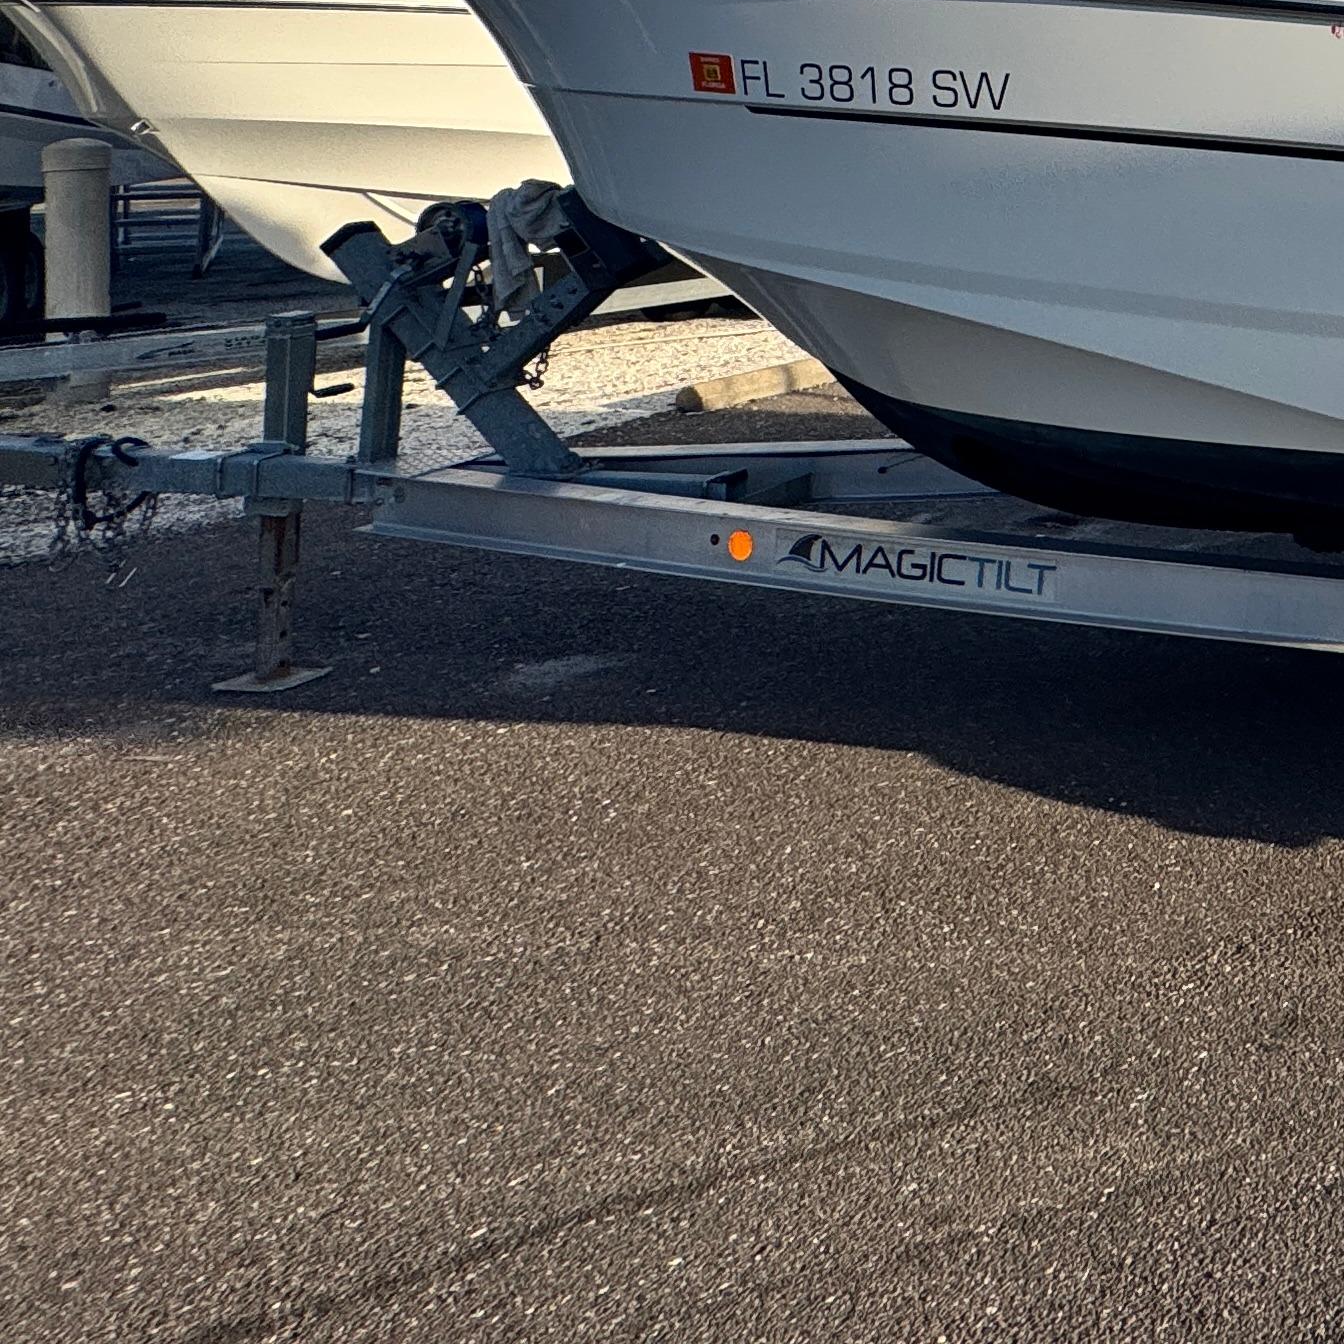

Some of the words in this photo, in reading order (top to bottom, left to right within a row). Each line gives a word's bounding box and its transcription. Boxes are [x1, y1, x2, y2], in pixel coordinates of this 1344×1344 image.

[740, 58, 786, 99] FL
[800, 62, 915, 107] 3818
[931, 69, 1011, 111] SW
[819, 538, 1058, 596] MAGICTILT
